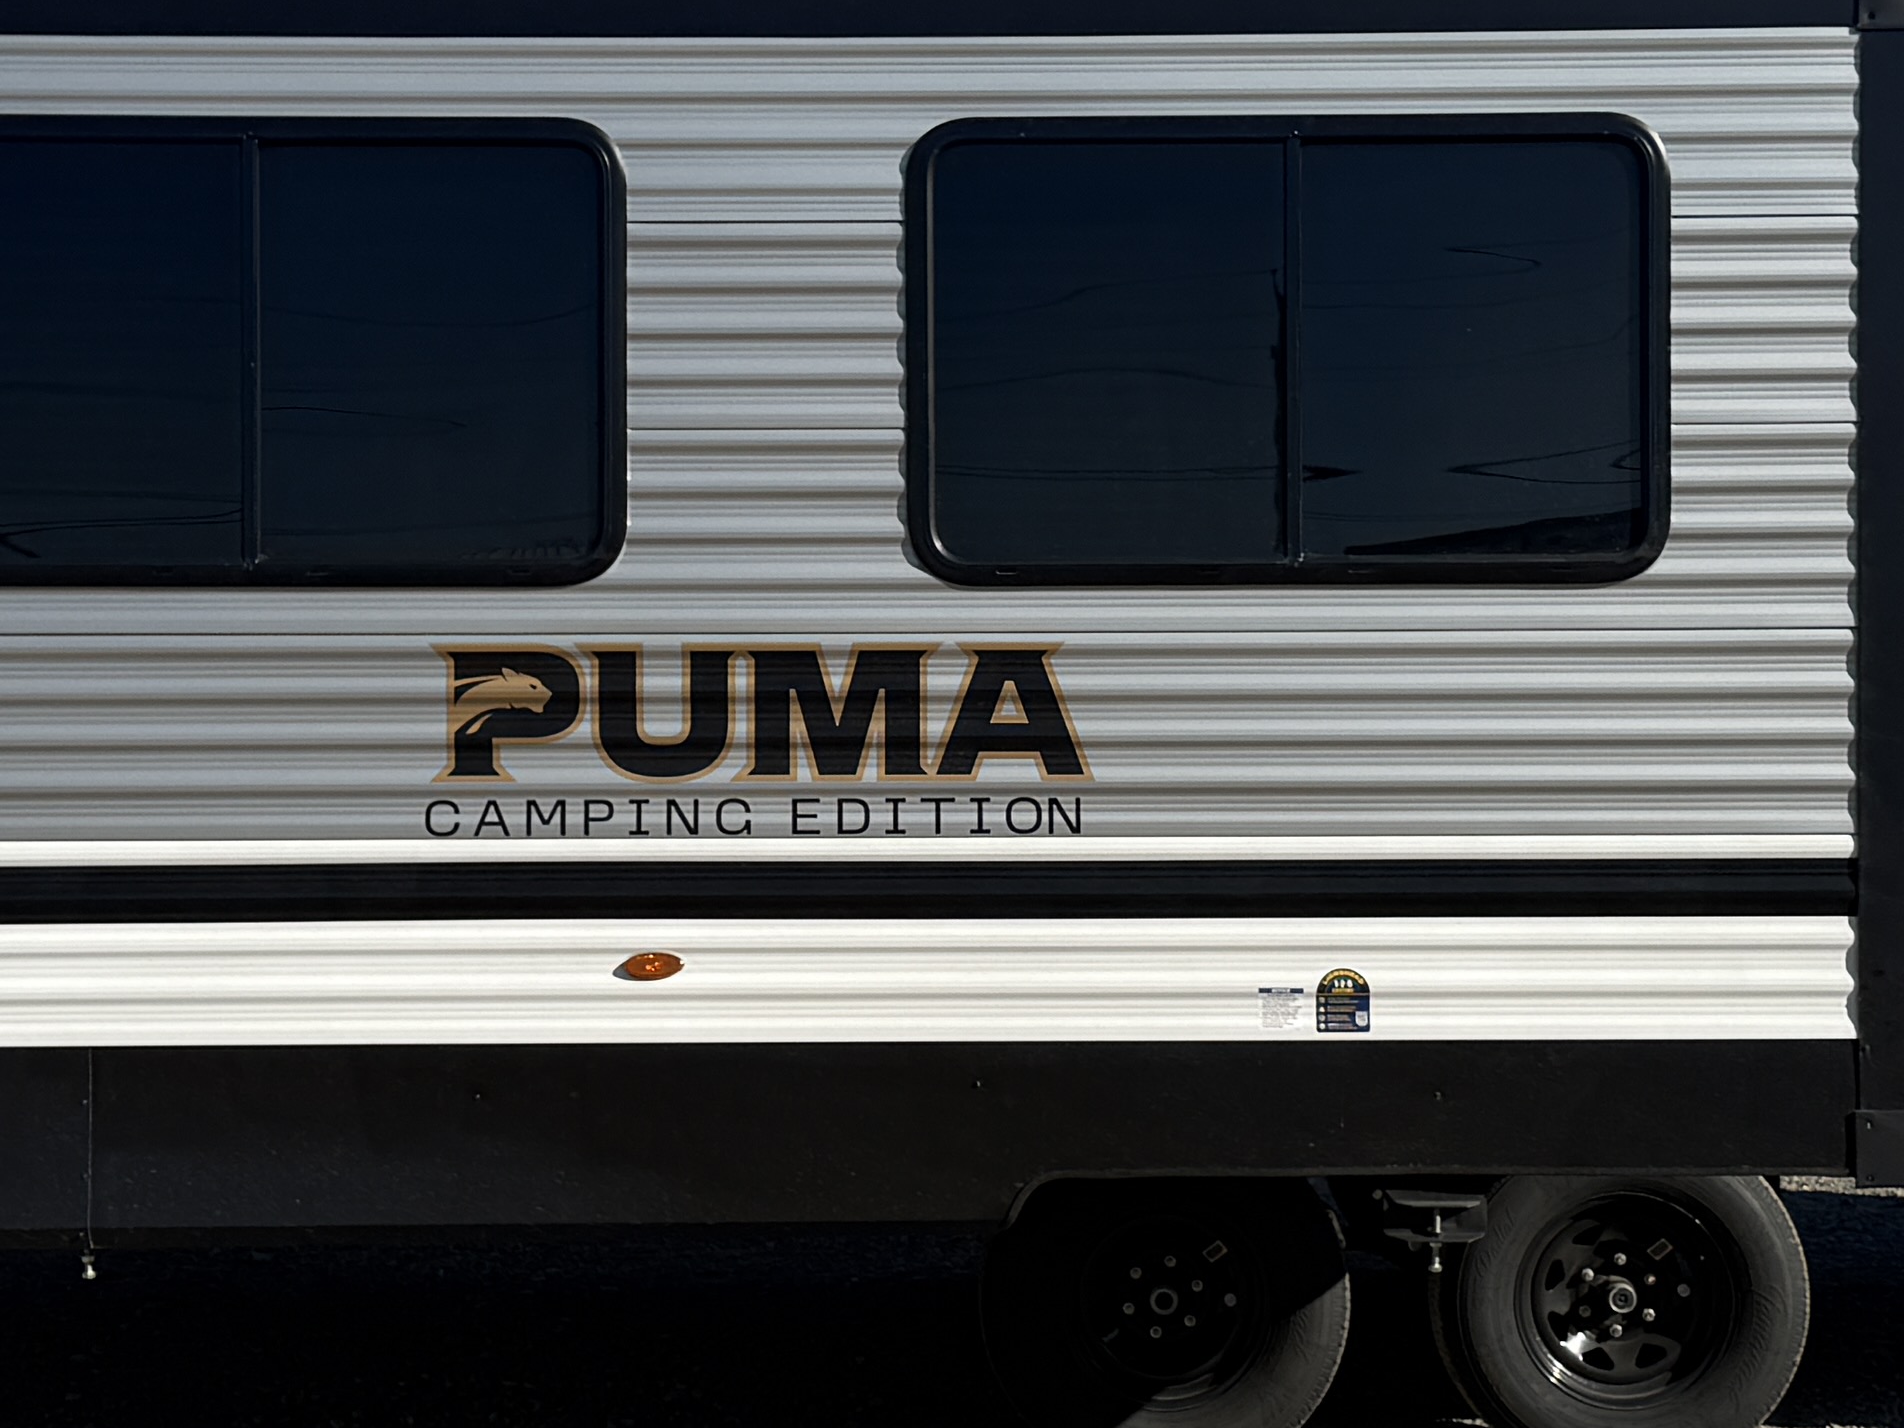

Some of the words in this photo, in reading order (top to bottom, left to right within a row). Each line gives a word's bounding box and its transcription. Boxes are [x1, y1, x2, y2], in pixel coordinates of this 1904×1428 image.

[429, 642, 1095, 783] PUMA
[424, 797, 752, 837] CAMPING
[790, 796, 1082, 836] EDITION
